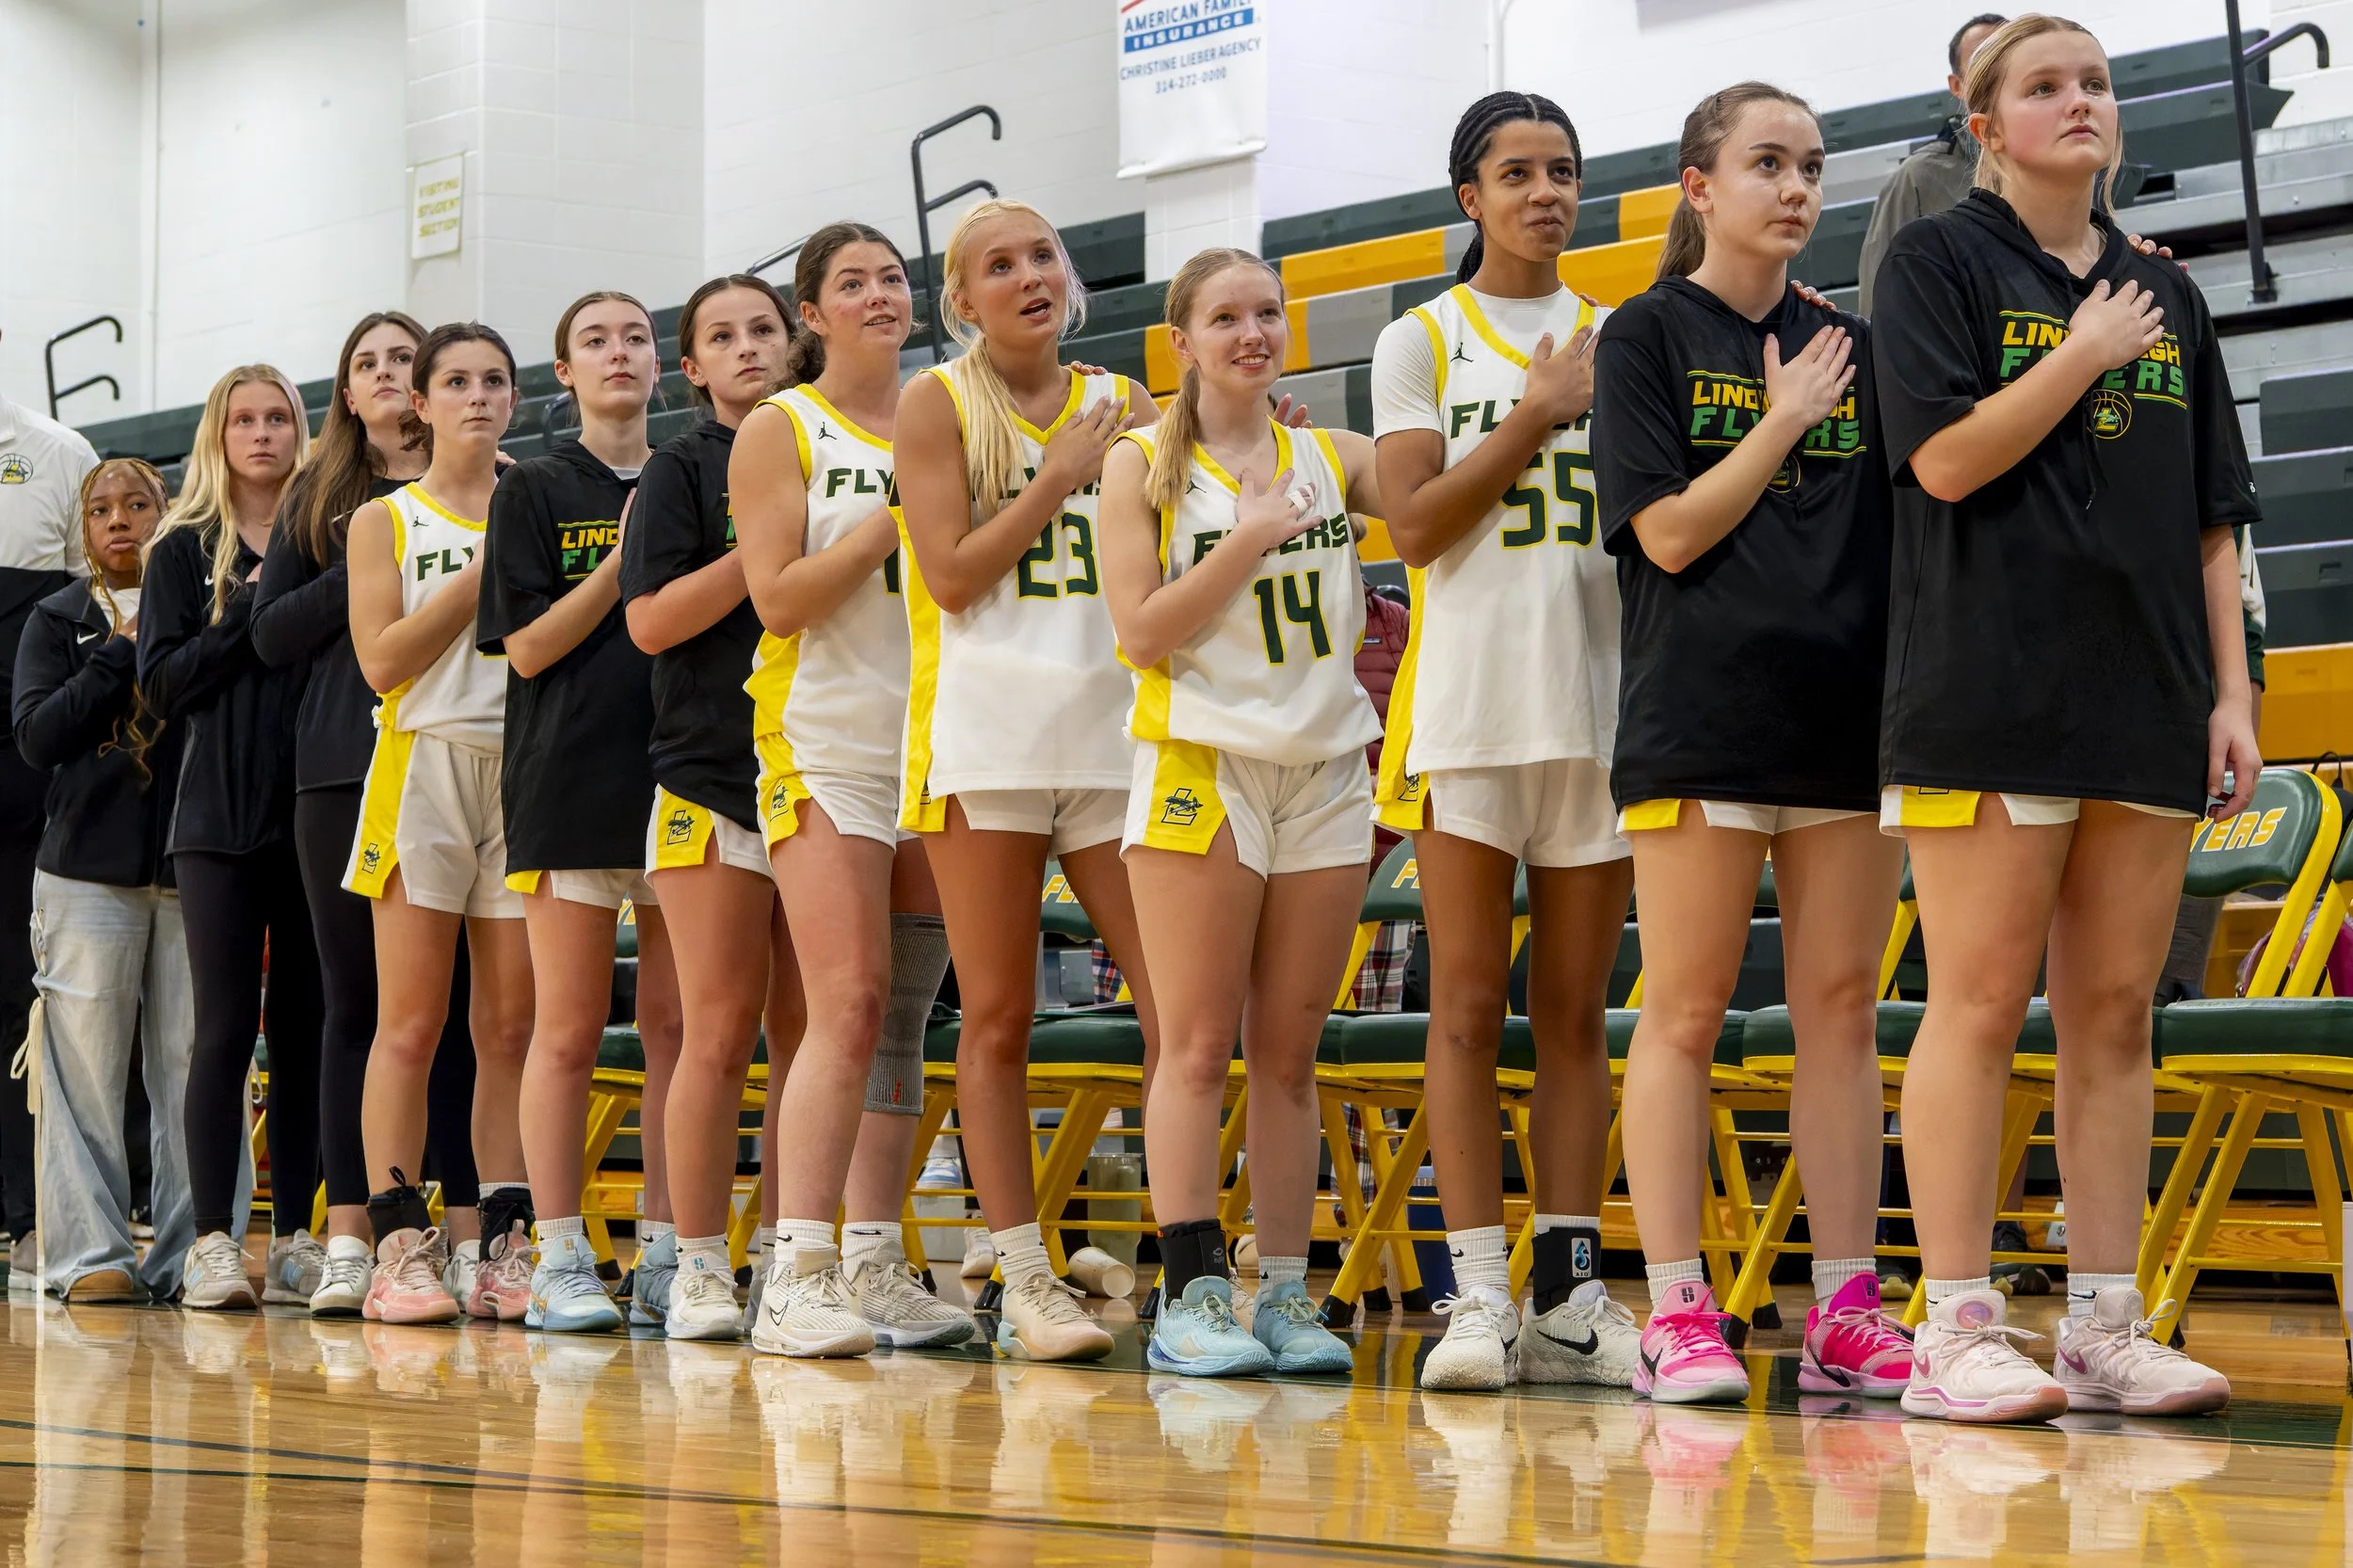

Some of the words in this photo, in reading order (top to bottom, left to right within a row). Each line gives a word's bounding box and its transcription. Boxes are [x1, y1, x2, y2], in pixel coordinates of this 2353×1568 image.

[1124, 3, 1199, 33] AMERICAN
[1133, 12, 1244, 50] INSURANCE
[1120, 56, 1177, 80] CHRISTINE
[1218, 37, 1261, 59] AGENCY
[2002, 321, 2181, 366] LINGH
[1999, 348, 2185, 396] FERS
[1690, 407, 1860, 449] FLRS
[1500, 449, 1597, 550] 55
[1016, 510, 1099, 600] 23
[1193, 513, 1350, 566] FERS
[1252, 568, 1334, 665] 14
